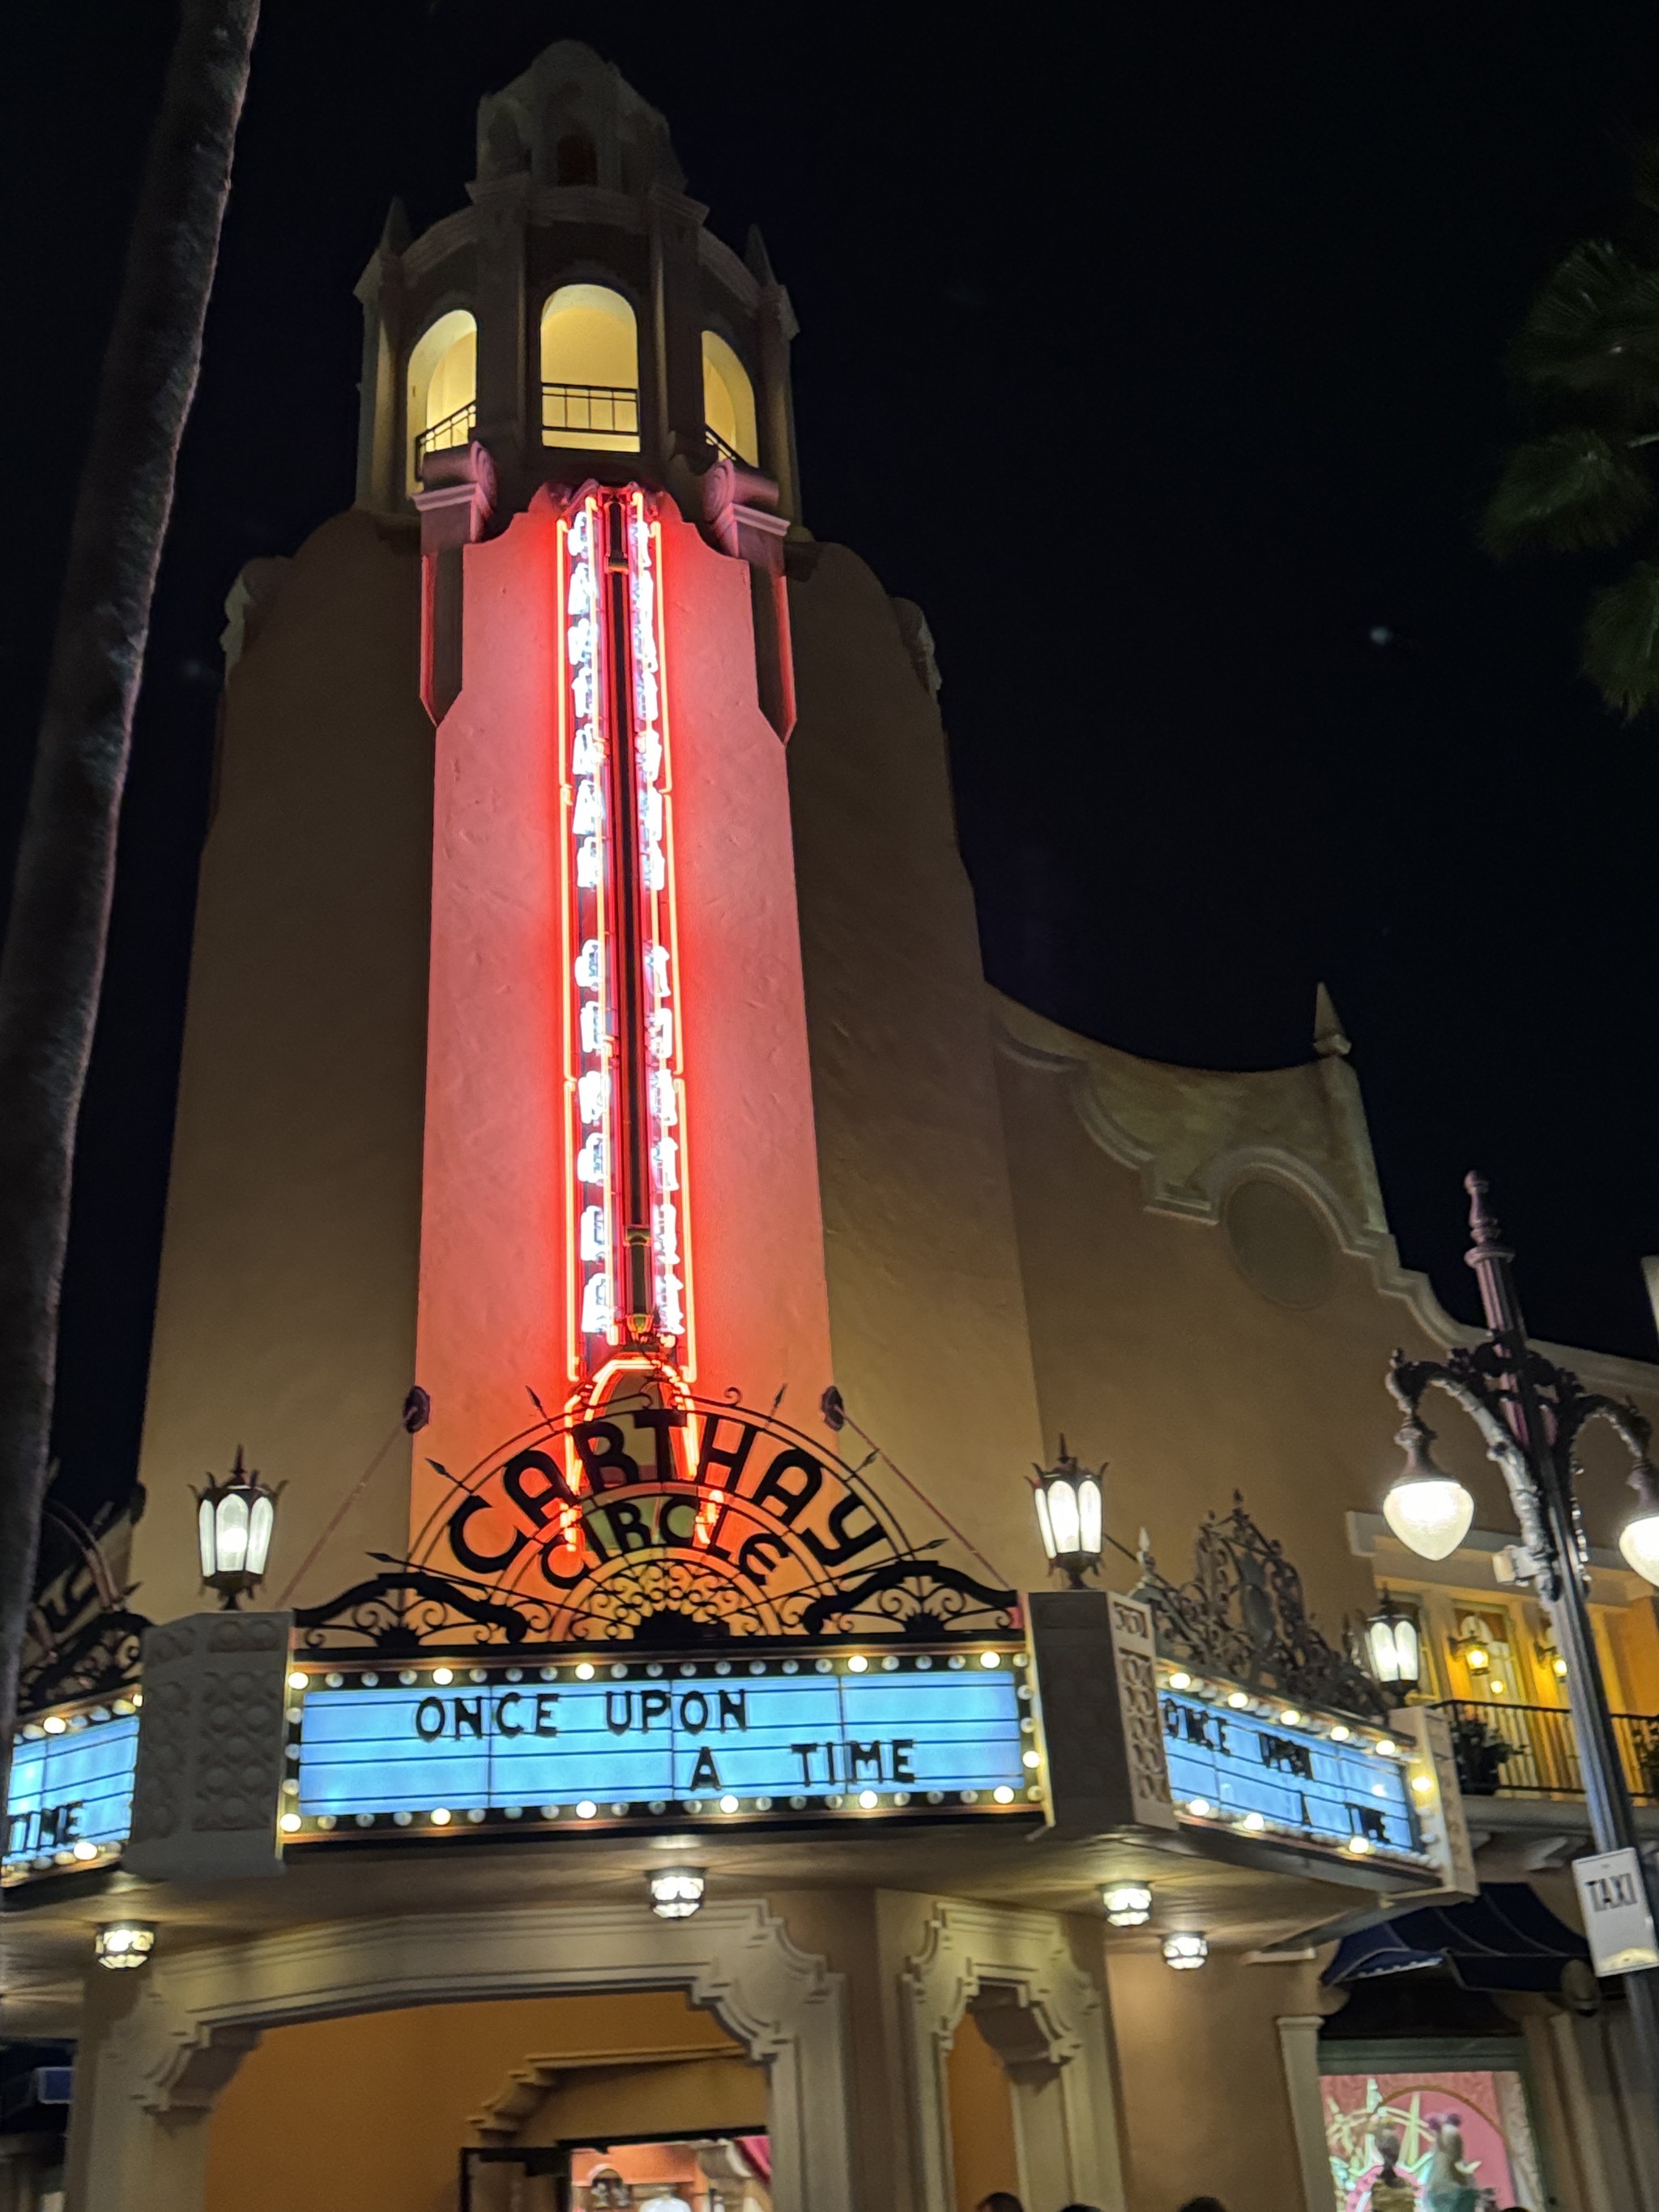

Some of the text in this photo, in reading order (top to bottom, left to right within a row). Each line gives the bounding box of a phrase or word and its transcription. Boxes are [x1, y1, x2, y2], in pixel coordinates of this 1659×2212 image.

[449, 1409, 887, 1574] CARTHAY
[540, 1493, 790, 1589] CIRCLE
[414, 1688, 748, 1742] ONCE UPON
[691, 1737, 919, 1791] A TIME
